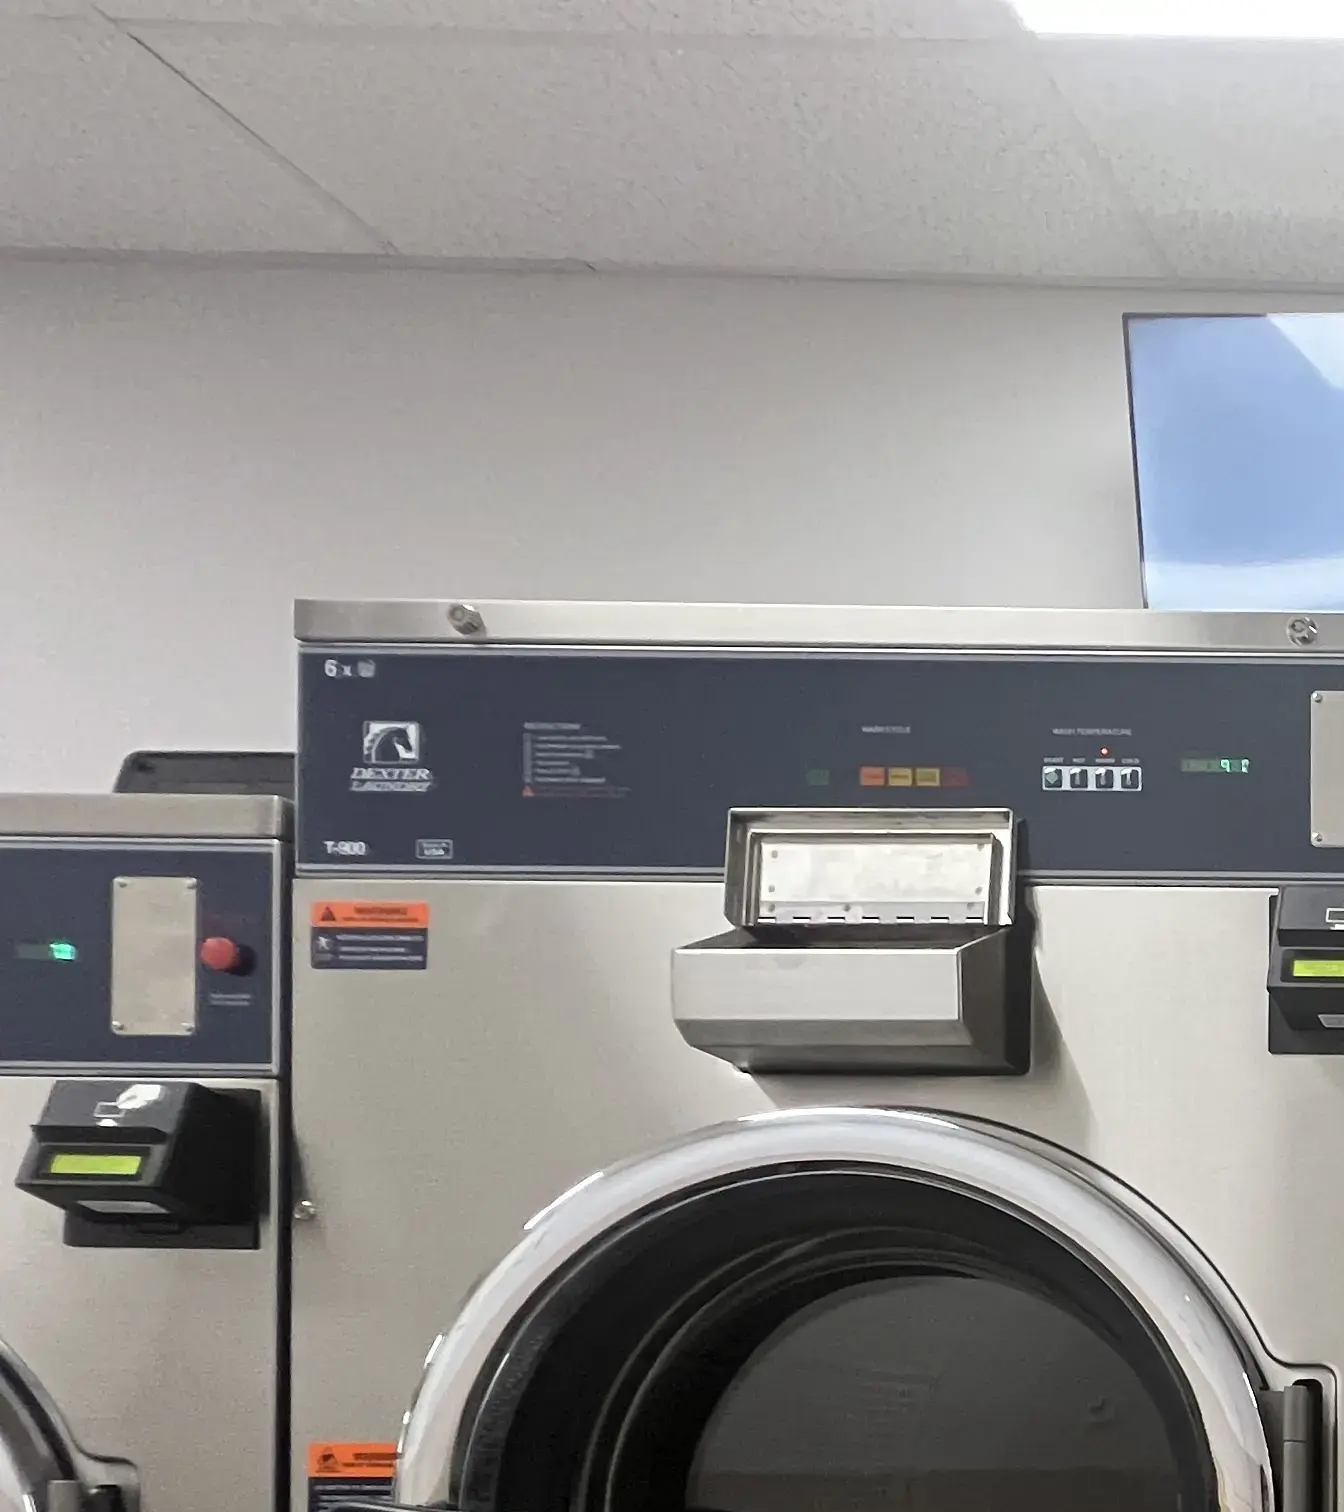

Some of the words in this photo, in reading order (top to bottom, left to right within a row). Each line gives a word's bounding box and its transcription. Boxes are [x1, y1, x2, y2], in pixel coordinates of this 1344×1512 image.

[324, 659, 337, 677] 6
[343, 665, 352, 676] x
[351, 768, 430, 779] DEXTER
[324, 841, 366, 855] T-900
